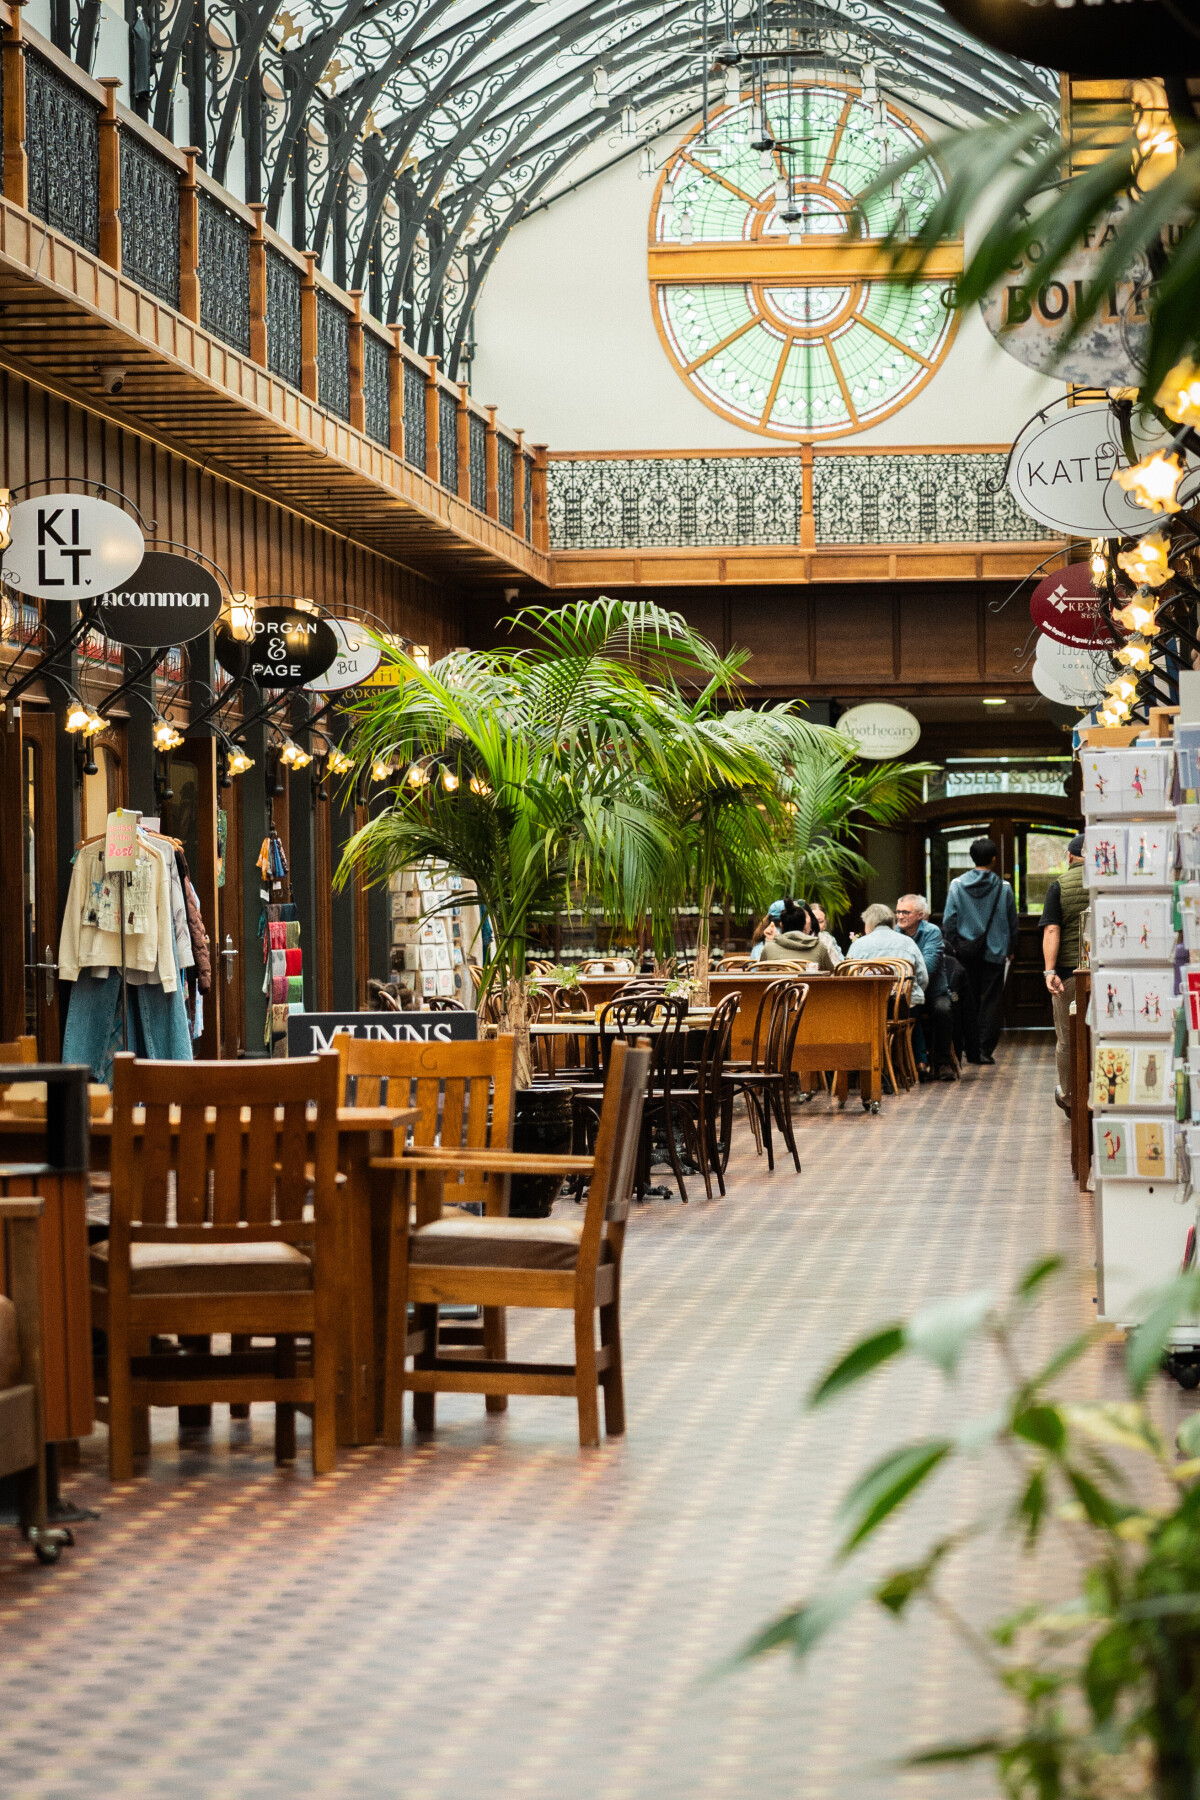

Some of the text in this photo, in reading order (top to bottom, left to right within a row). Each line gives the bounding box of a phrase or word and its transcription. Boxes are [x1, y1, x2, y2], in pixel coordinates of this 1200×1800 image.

[37, 508, 80, 546] KI
[37, 548, 92, 586] LT
[253, 622, 317, 634] ORGAN
[267, 637, 287, 661] &
[252, 664, 302, 677] PAGE
[842, 720, 915, 740] Apothecary
[1008, 769, 1022, 784] &
[108, 843, 133, 857] Best
